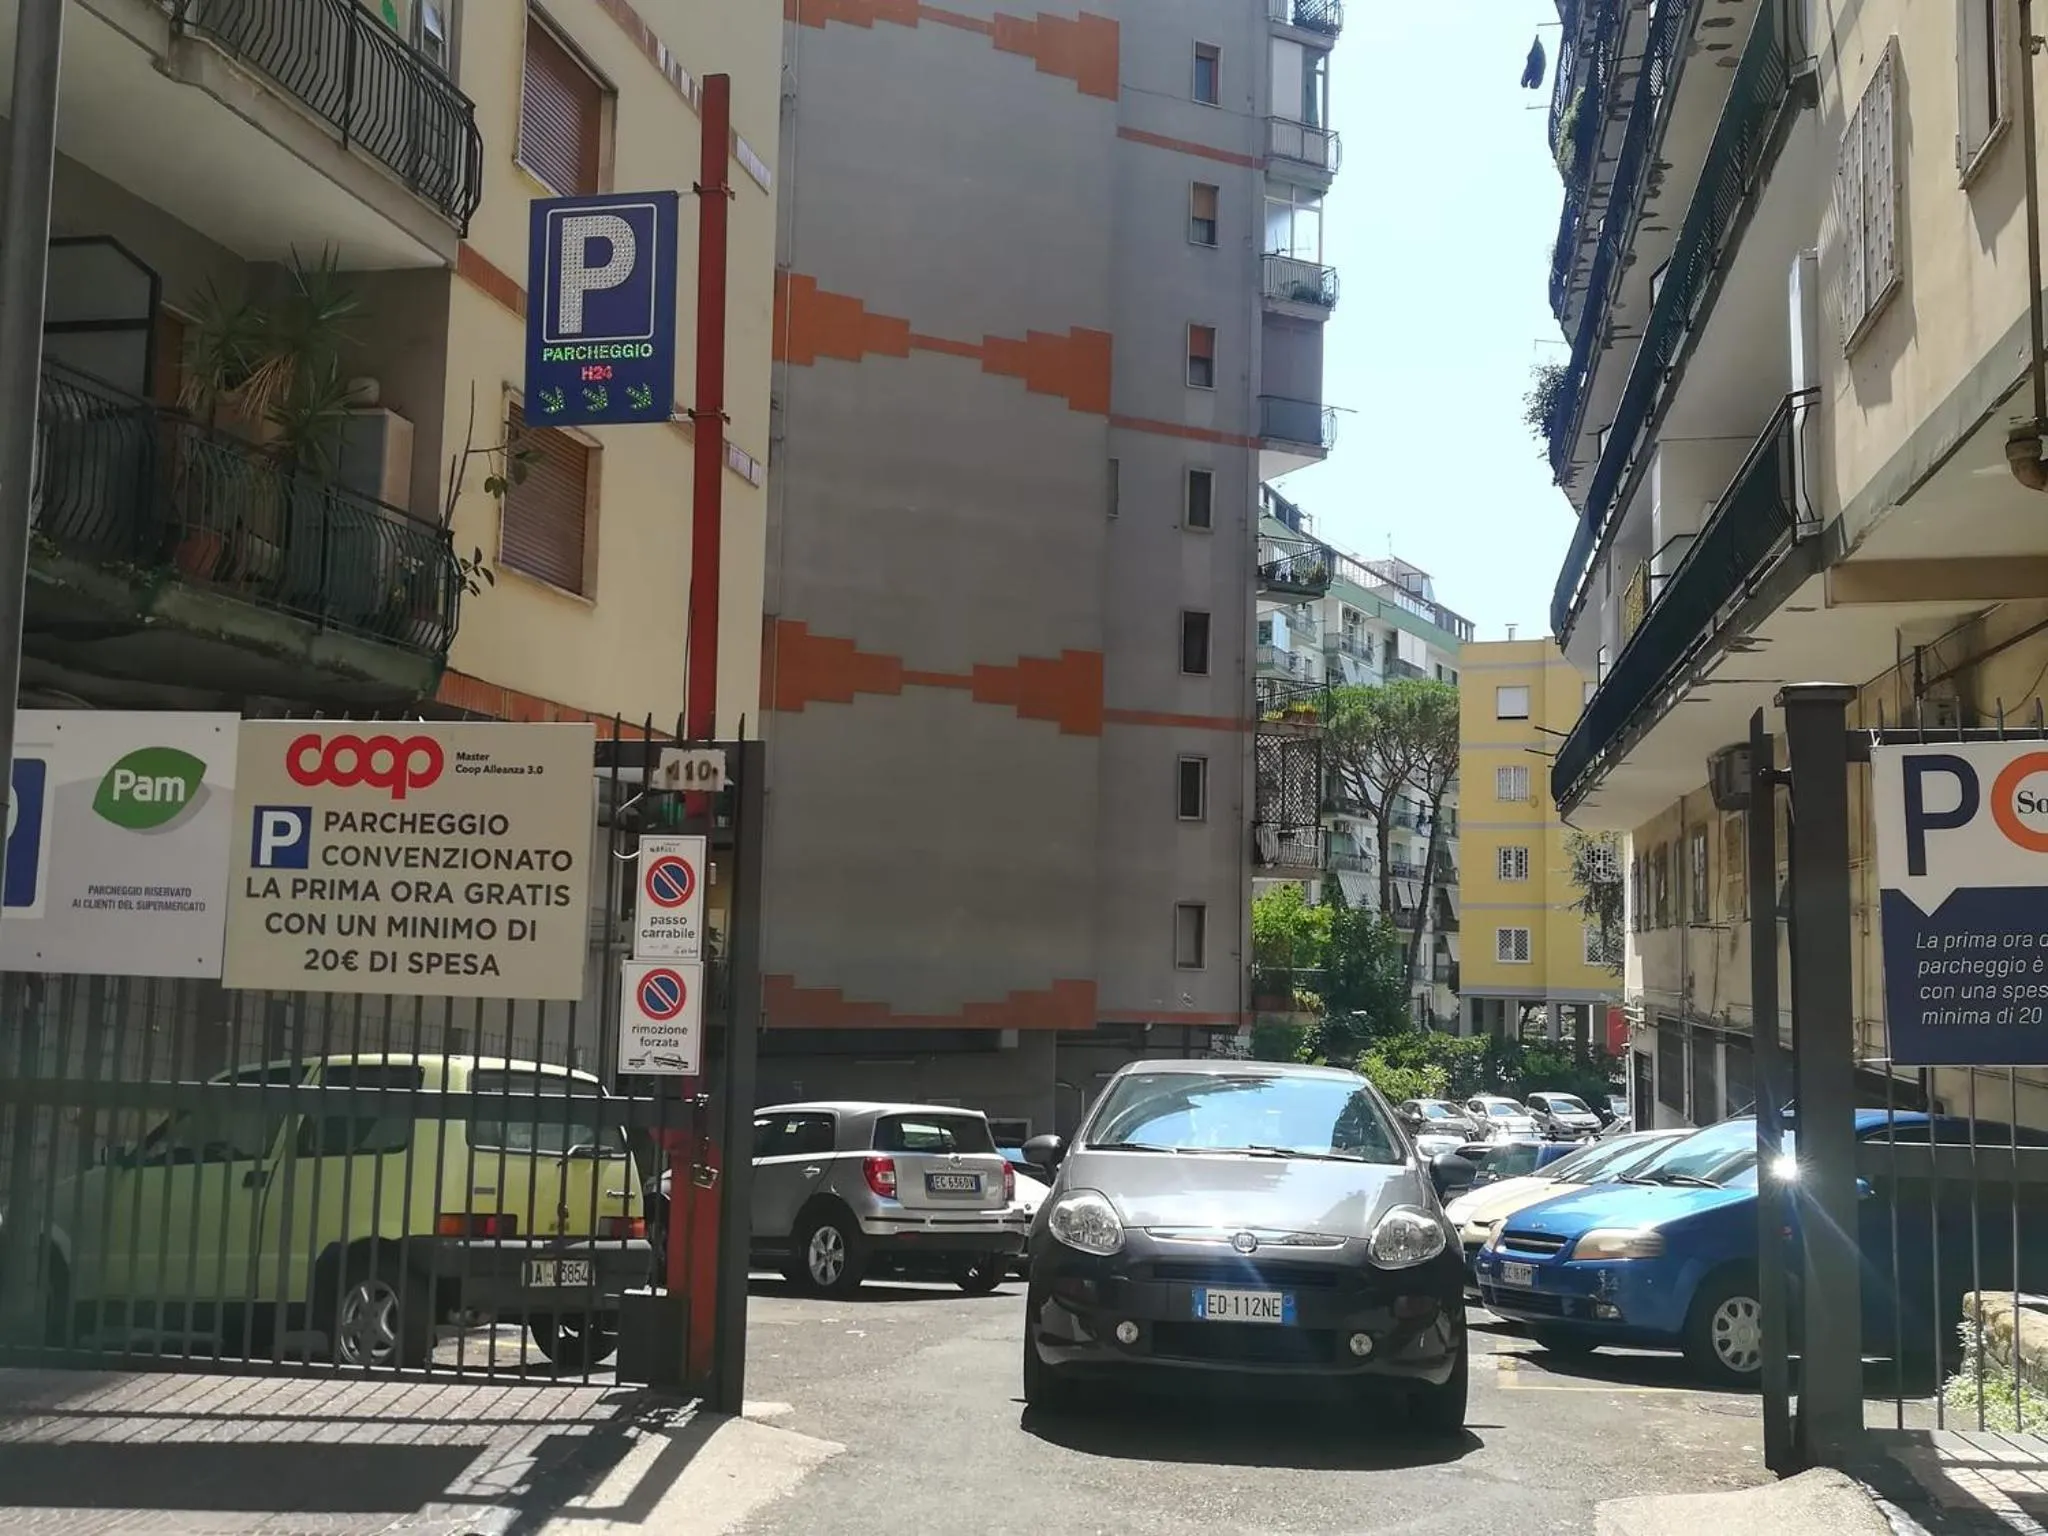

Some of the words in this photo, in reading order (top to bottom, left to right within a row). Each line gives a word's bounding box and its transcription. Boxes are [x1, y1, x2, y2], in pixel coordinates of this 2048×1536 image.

[558, 214, 636, 334] P
[542, 343, 653, 362] PARCHEGGIO
[581, 365, 613, 381] H24
[456, 752, 490, 761] Master
[455, 764, 481, 776] Coop
[527, 765, 544, 775] 3.0
[112, 768, 185, 802] Pam
[323, 811, 509, 836] PARCHEGGIO
[1902, 754, 1980, 876] P
[259, 811, 303, 866] P
[321, 845, 573, 872] CONVENZIONATO
[88, 885, 143, 897] PARCHEGGIO
[144, 887, 192, 898] RISERVATO
[245, 877, 281, 899] LA
[291, 878, 380, 902] PRIMA
[390, 881, 454, 905] ORA
[464, 883, 571, 907] GRATIS
[83, 899, 116, 910] CLIENTI
[118, 900, 134, 911] DEL
[136, 900, 206, 912] SUPERMERCATO
[264, 912, 327, 935] CON
[336, 914, 376, 938] UN
[386, 916, 497, 941] MINIMO
[507, 919, 537, 942] DI
[650, 915, 688, 926] passo
[641, 928, 696, 940] carrabile
[1916, 932, 1939, 949] La
[1943, 931, 1998, 953] prima
[2003, 934, 2034, 948] ora
[303, 949, 359, 972] 20€
[369, 952, 397, 973] DI
[407, 952, 500, 977] SPESA
[1918, 956, 2027, 979] parcheggio
[1920, 986, 1955, 999] con
[1961, 985, 1997, 999] una
[2002, 985, 2048, 1003] spes
[1921, 1007, 1991, 1025] minima
[1996, 1007, 2014, 1024] di
[2018, 1006, 2043, 1024] 20
[631, 1025, 688, 1036] rimozione
[640, 1035, 680, 1048] forzata
